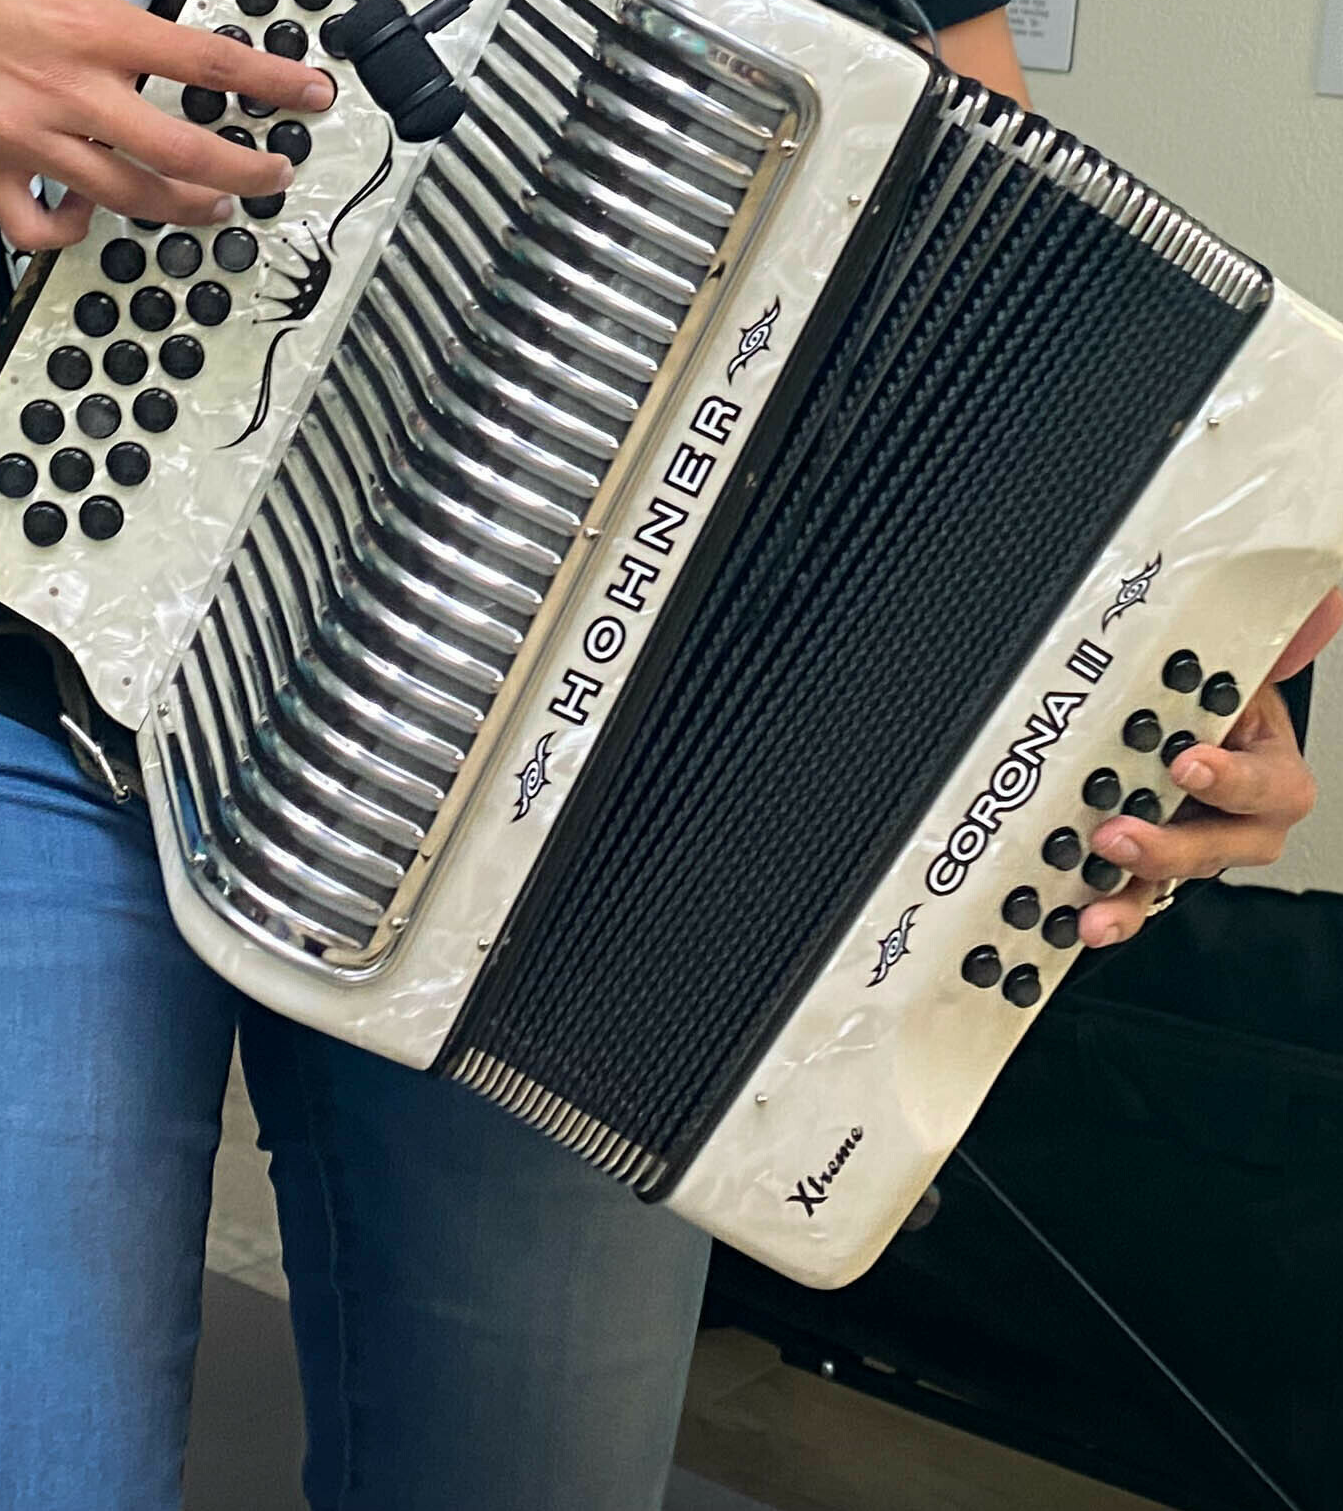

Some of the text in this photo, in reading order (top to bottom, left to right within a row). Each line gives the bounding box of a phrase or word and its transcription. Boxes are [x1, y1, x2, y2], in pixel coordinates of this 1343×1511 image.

[548, 393, 743, 726] HOHNER
[925, 638, 1114, 897] CORONA II
[784, 1125, 864, 1219] Xtreme
